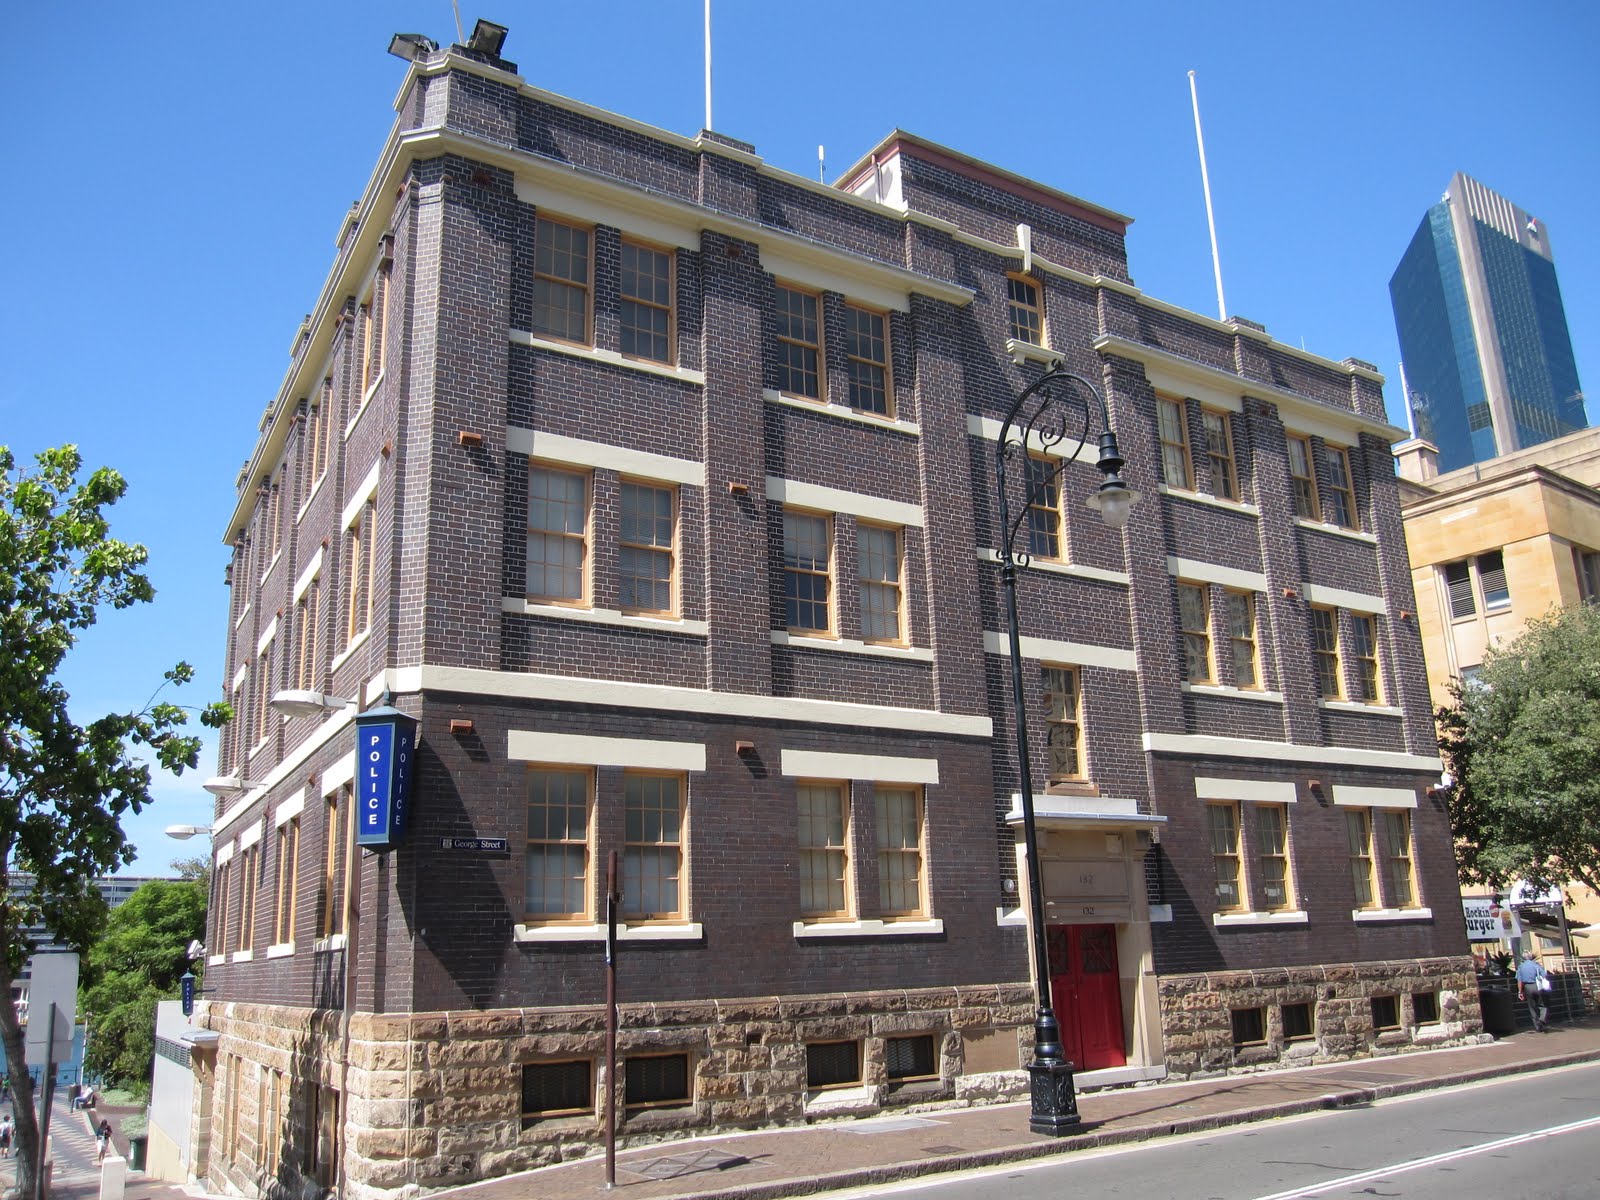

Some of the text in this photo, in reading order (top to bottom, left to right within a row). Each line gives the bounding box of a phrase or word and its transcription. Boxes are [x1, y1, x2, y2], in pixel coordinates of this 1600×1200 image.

[369, 736, 380, 825] POLICE
[395, 738, 407, 825] POLICE
[454, 839, 501, 849] George Street
[1082, 906, 1095, 915] 132
[1465, 906, 1490, 918] Rockin
[1466, 918, 1495, 935] urger
